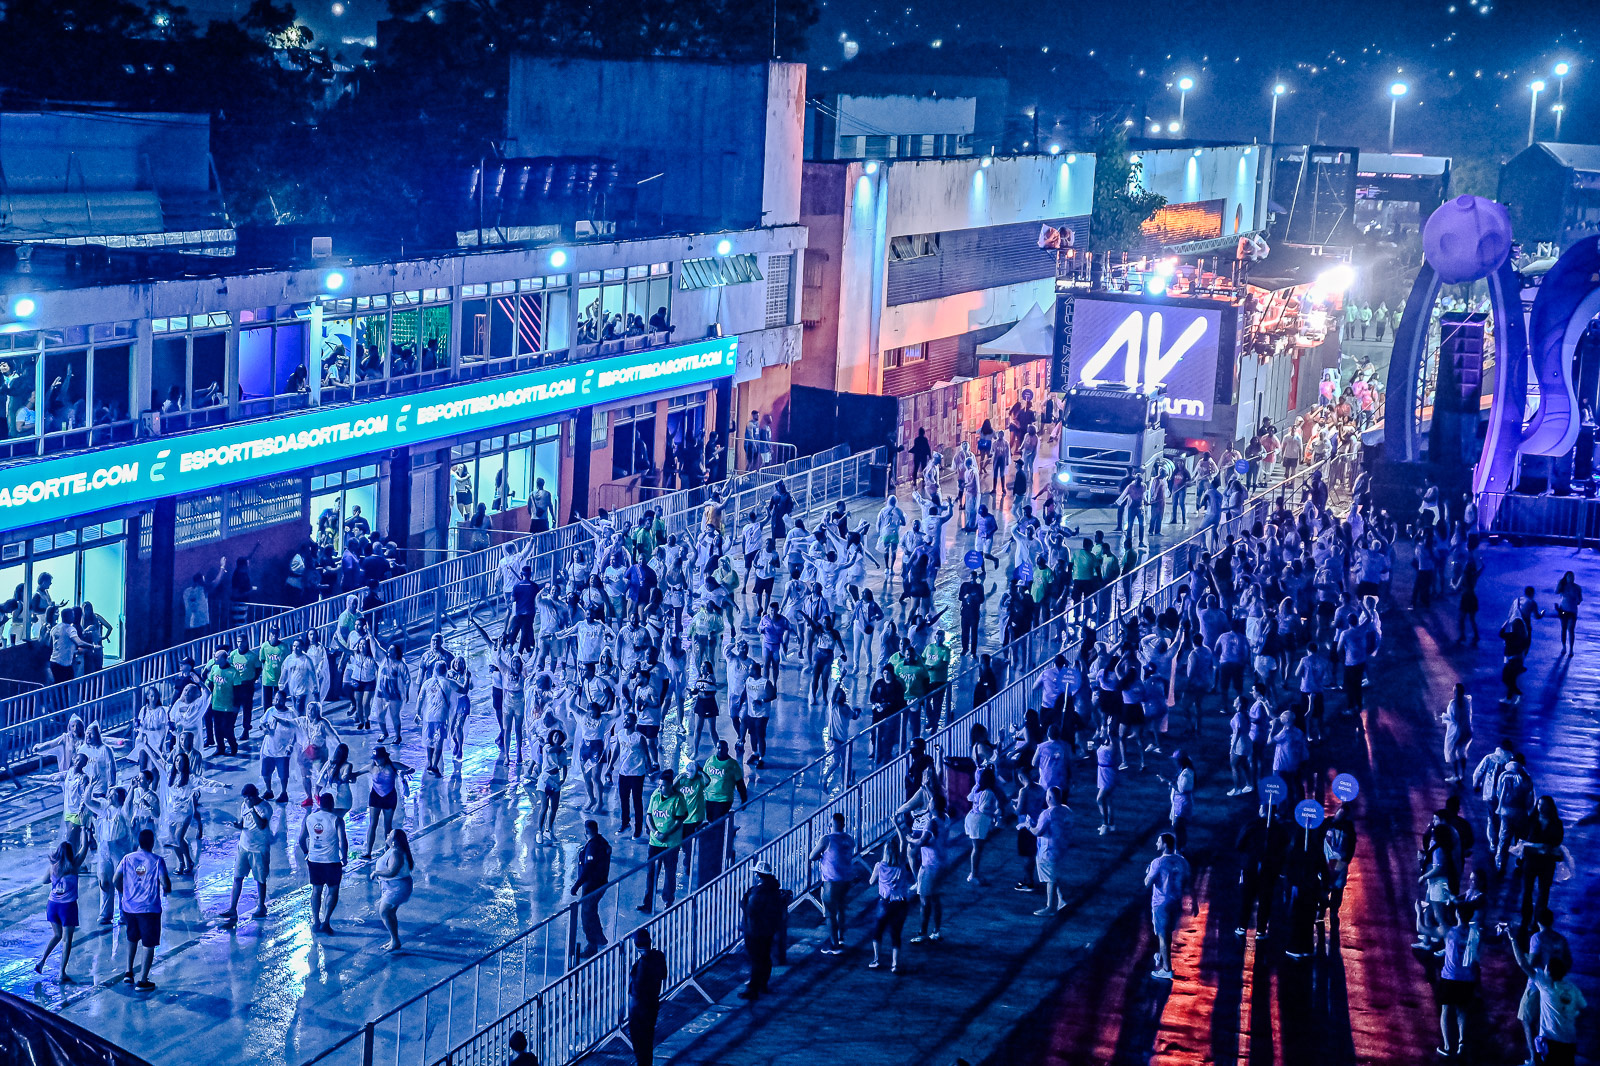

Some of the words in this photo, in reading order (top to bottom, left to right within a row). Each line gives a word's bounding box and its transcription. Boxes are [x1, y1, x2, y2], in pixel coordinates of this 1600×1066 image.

[598, 349, 723, 388] ESPORTESDASORTE.COM
[416, 377, 577, 425] ESPORTESDASORTE.COM
[1079, 390, 1132, 399] ALUCINANTE
[179, 414, 389, 473] ESPORTESDASORTE.COM
